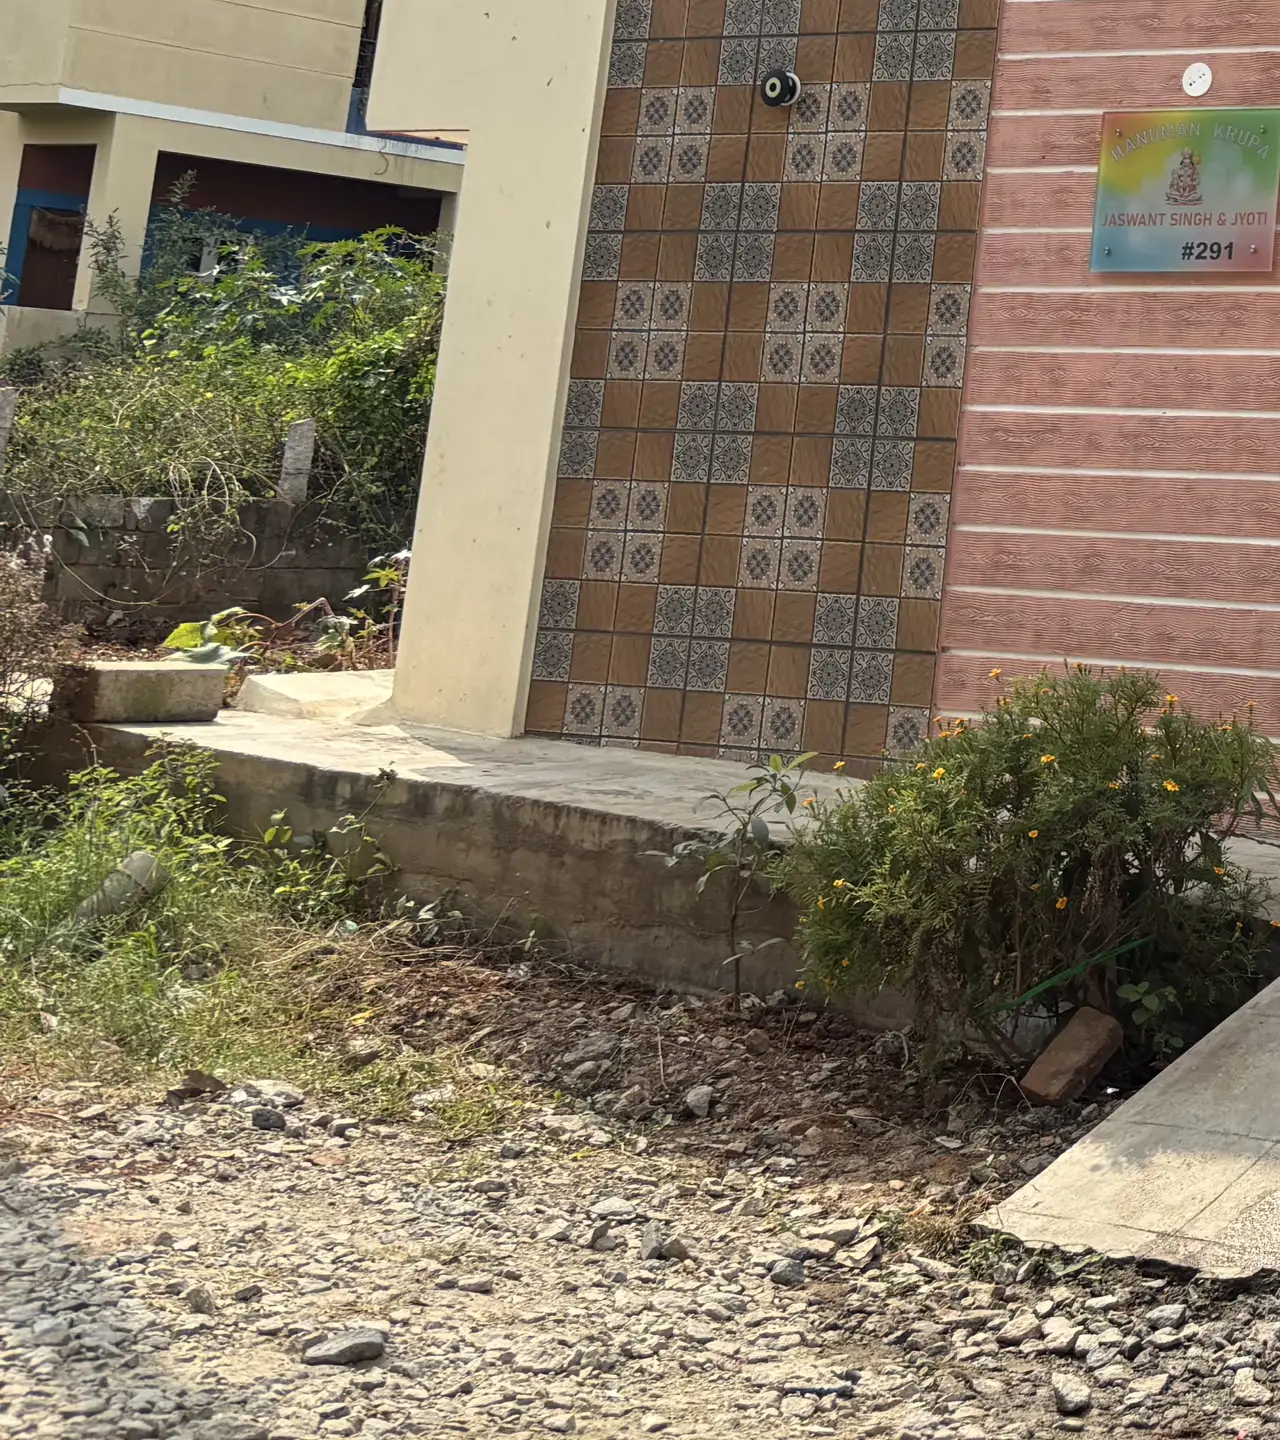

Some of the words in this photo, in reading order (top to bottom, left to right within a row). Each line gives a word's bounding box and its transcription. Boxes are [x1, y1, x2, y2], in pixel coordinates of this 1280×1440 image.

[1109, 121, 1201, 163] HANUMAN
[1213, 122, 1270, 160] KRUPA
[1101, 212, 1167, 228] JASWANT
[1169, 212, 1213, 227] SINGH
[1217, 212, 1226, 226] &
[1230, 211, 1268, 227] JYOTI
[1181, 241, 1234, 262] #291
